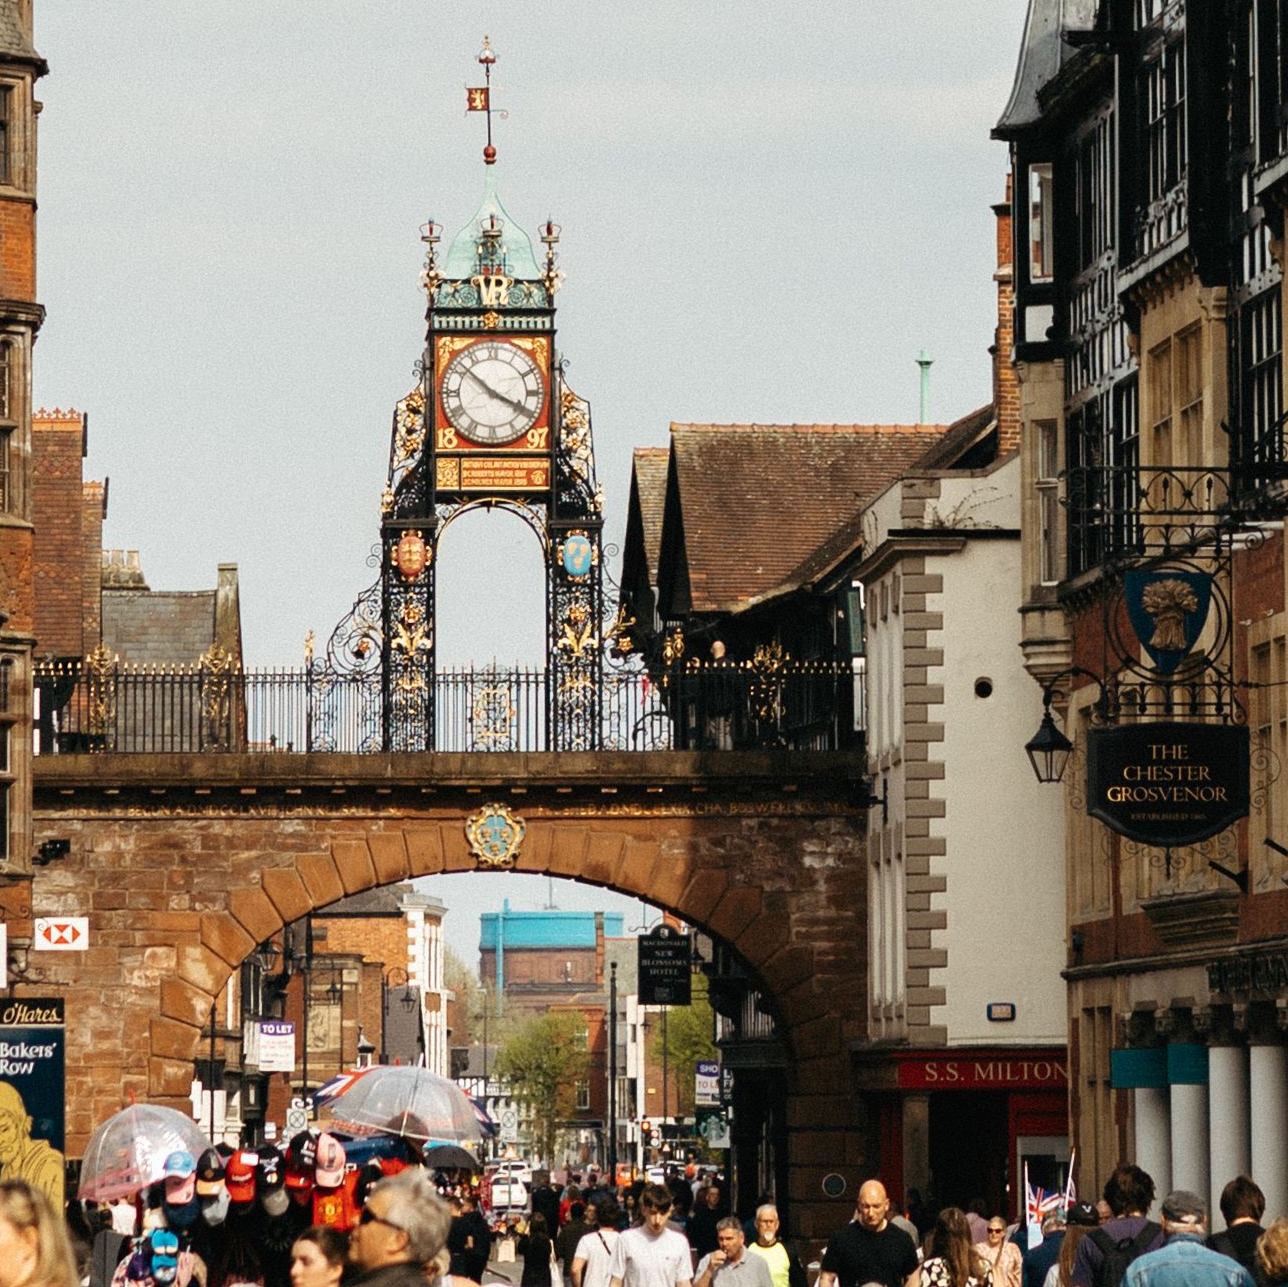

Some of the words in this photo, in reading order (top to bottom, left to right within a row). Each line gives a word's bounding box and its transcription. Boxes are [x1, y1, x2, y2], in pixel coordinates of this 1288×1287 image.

[438, 428, 458, 448] 18
[526, 427, 549, 448] 97
[1147, 744, 1189, 760] THE
[1123, 766, 1212, 781] CHESTER
[1107, 786, 1228, 802] GROSVENOR
[3, 1003, 62, 1024] O'Hares
[262, 1024, 275, 1033] TO
[276, 1024, 292, 1033] LET
[0, 1042, 57, 1058] Bakers'
[0, 1059, 34, 1076] Row
[699, 1064, 719, 1073] SHO
[925, 1062, 965, 1081] S.S.
[974, 1062, 1068, 1081] MILTON
